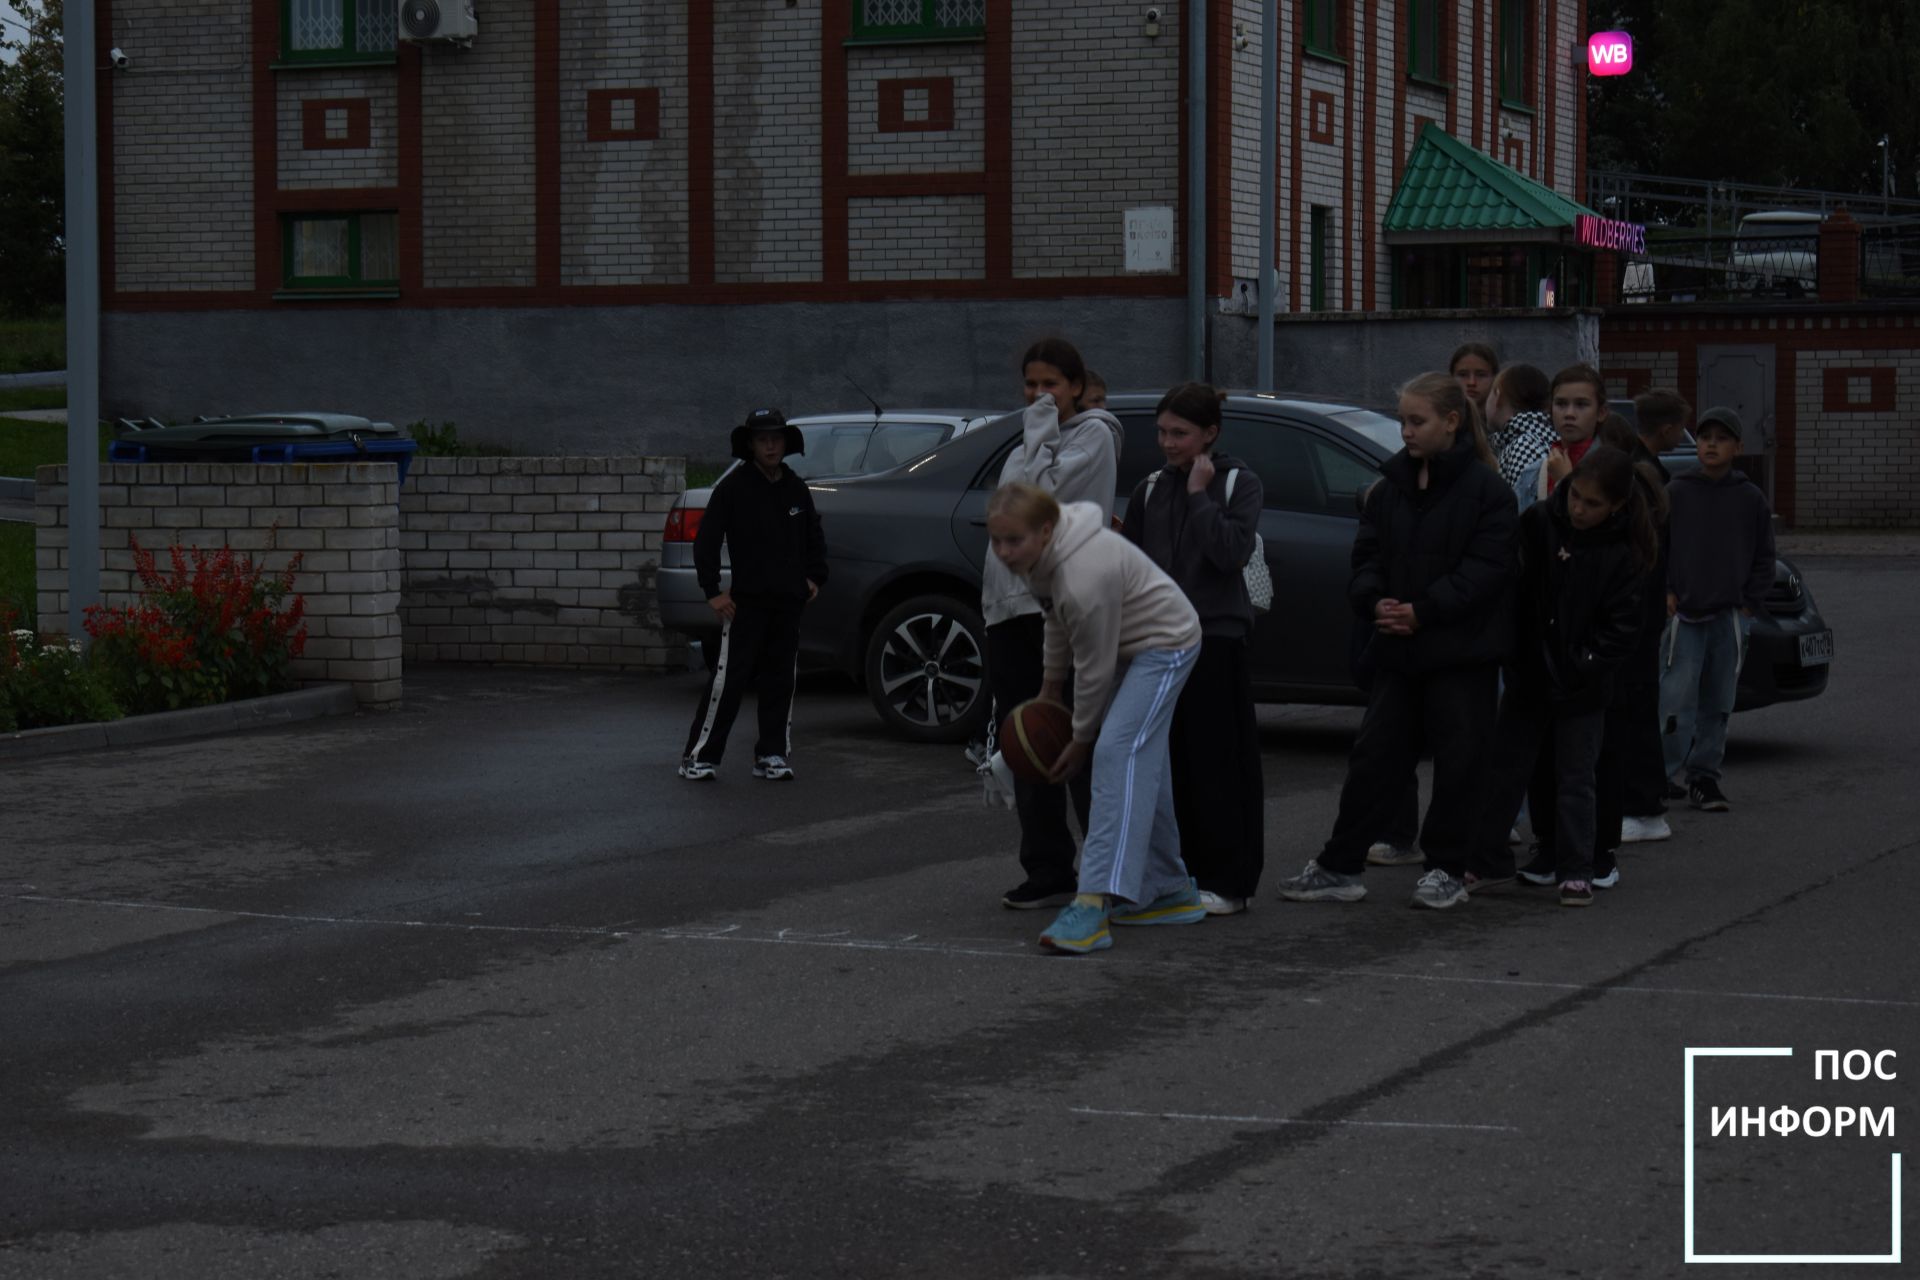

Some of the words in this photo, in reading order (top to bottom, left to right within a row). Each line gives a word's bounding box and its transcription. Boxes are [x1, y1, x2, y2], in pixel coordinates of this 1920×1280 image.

[1591, 43, 1628, 64] WB
[1581, 215, 1646, 254] WILDBERRIES
[1545, 290, 1555, 307] WB
